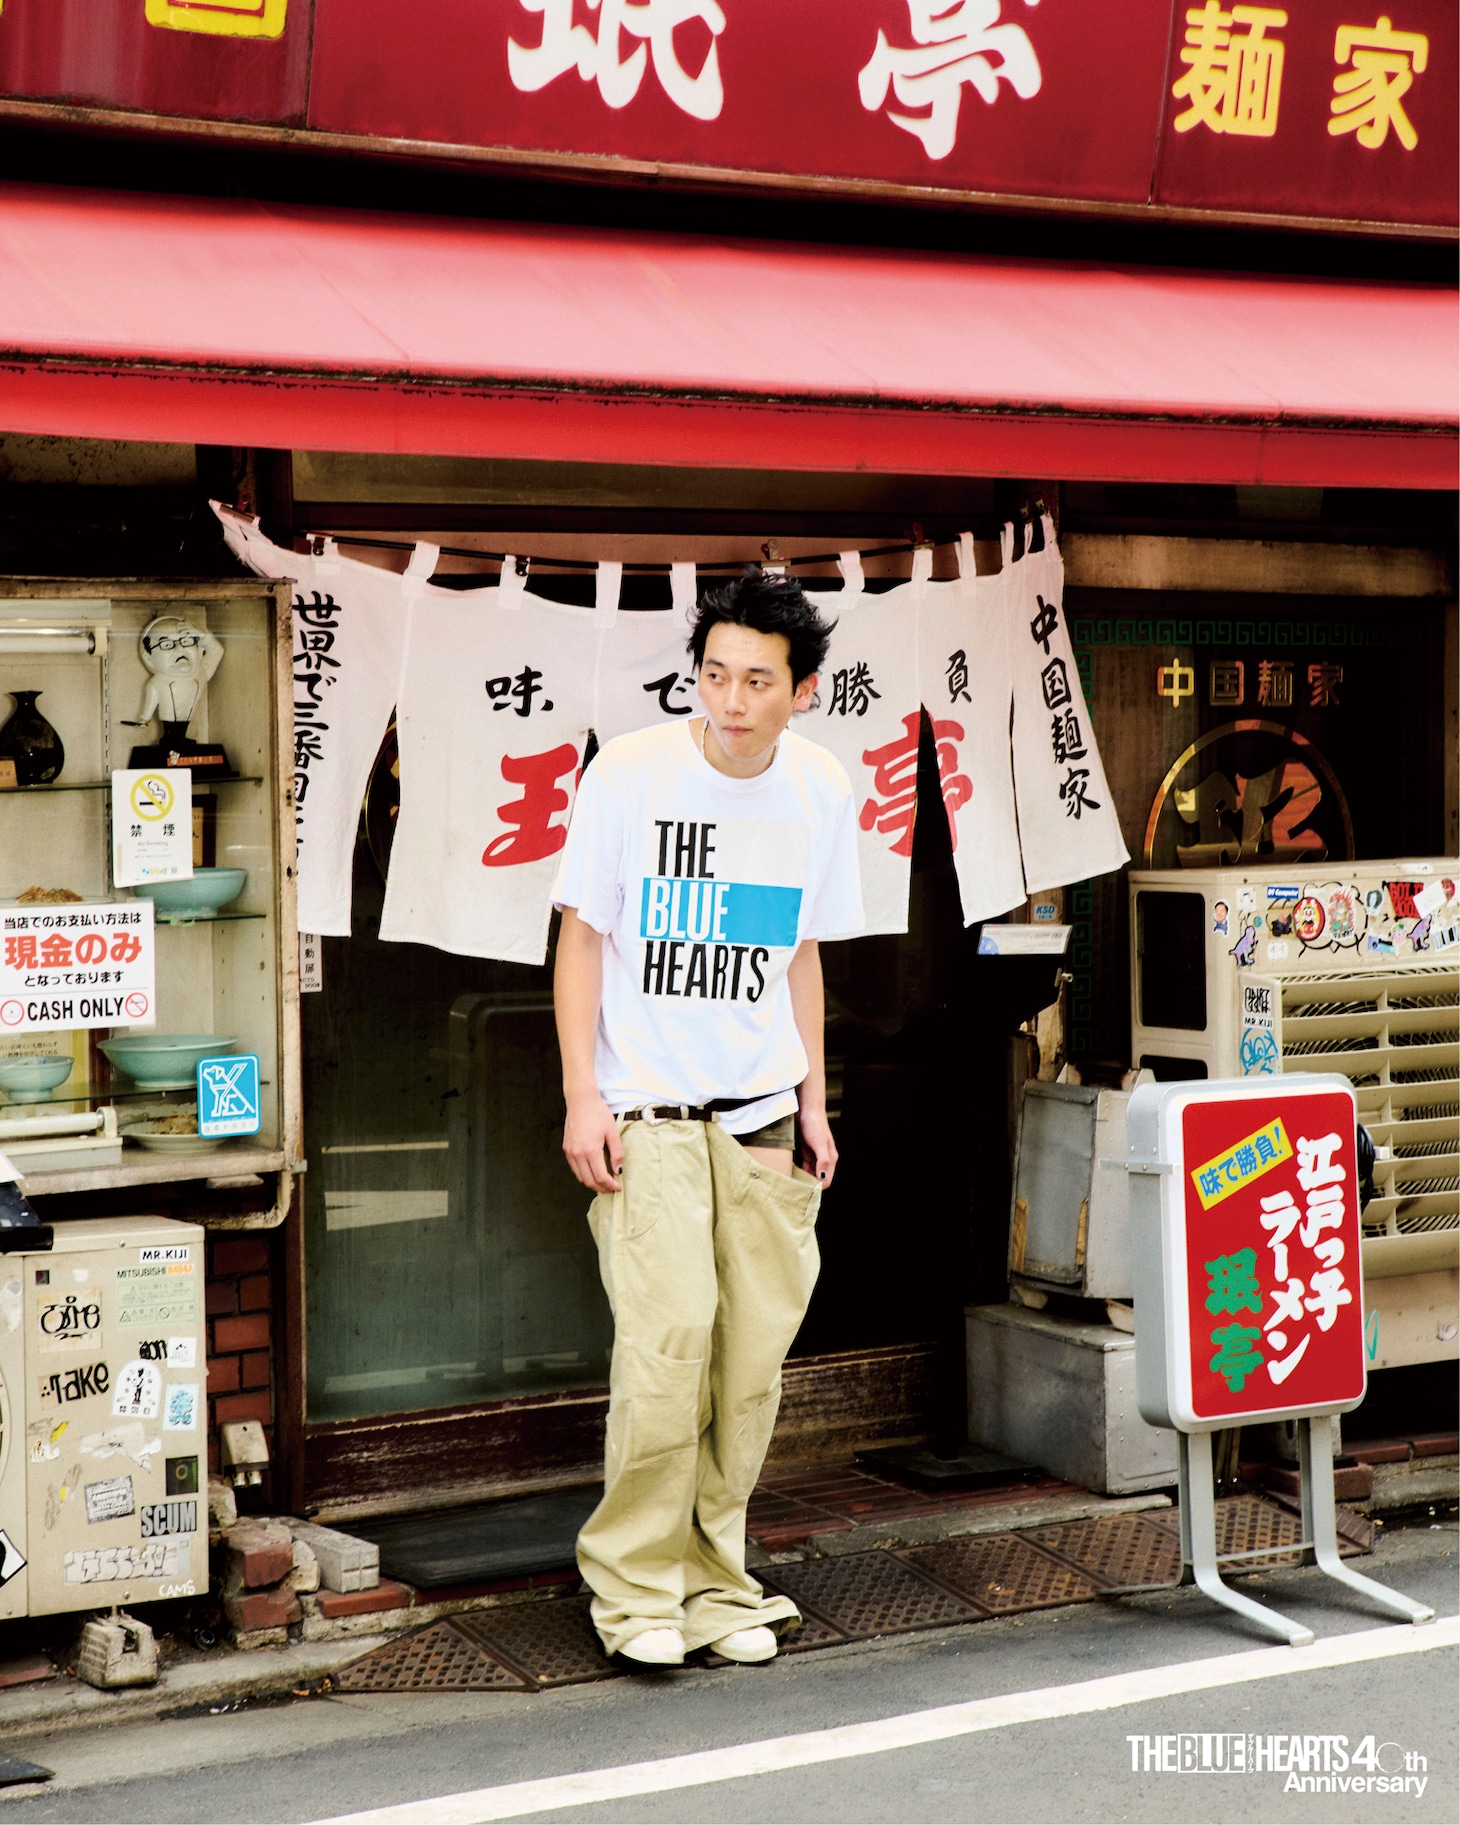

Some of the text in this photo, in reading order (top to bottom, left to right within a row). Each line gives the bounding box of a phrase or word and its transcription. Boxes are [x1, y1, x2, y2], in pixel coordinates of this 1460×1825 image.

[1172, 0, 1430, 152] 麺家
[1156, 657, 1344, 709] 中国麺家
[130, 823, 176, 838] 禁煙
[655, 820, 717, 879] THE
[4, 912, 142, 930] 当店でのお支払い方法は
[646, 878, 730, 941] BLUE
[1036, 904, 1056, 915] KSD
[4, 932, 142, 971] 現金のみ
[24, 970, 124, 987] となっております
[643, 940, 769, 1003] HEARTS
[27, 997, 124, 1021] CASH ONLY
[1295, 1132, 1353, 1332] 江戸っ子
[117, 1266, 166, 1279] MITSUBISHI
[1259, 1190, 1311, 1385] ラーメン
[141, 1501, 197, 1538] SCUM
